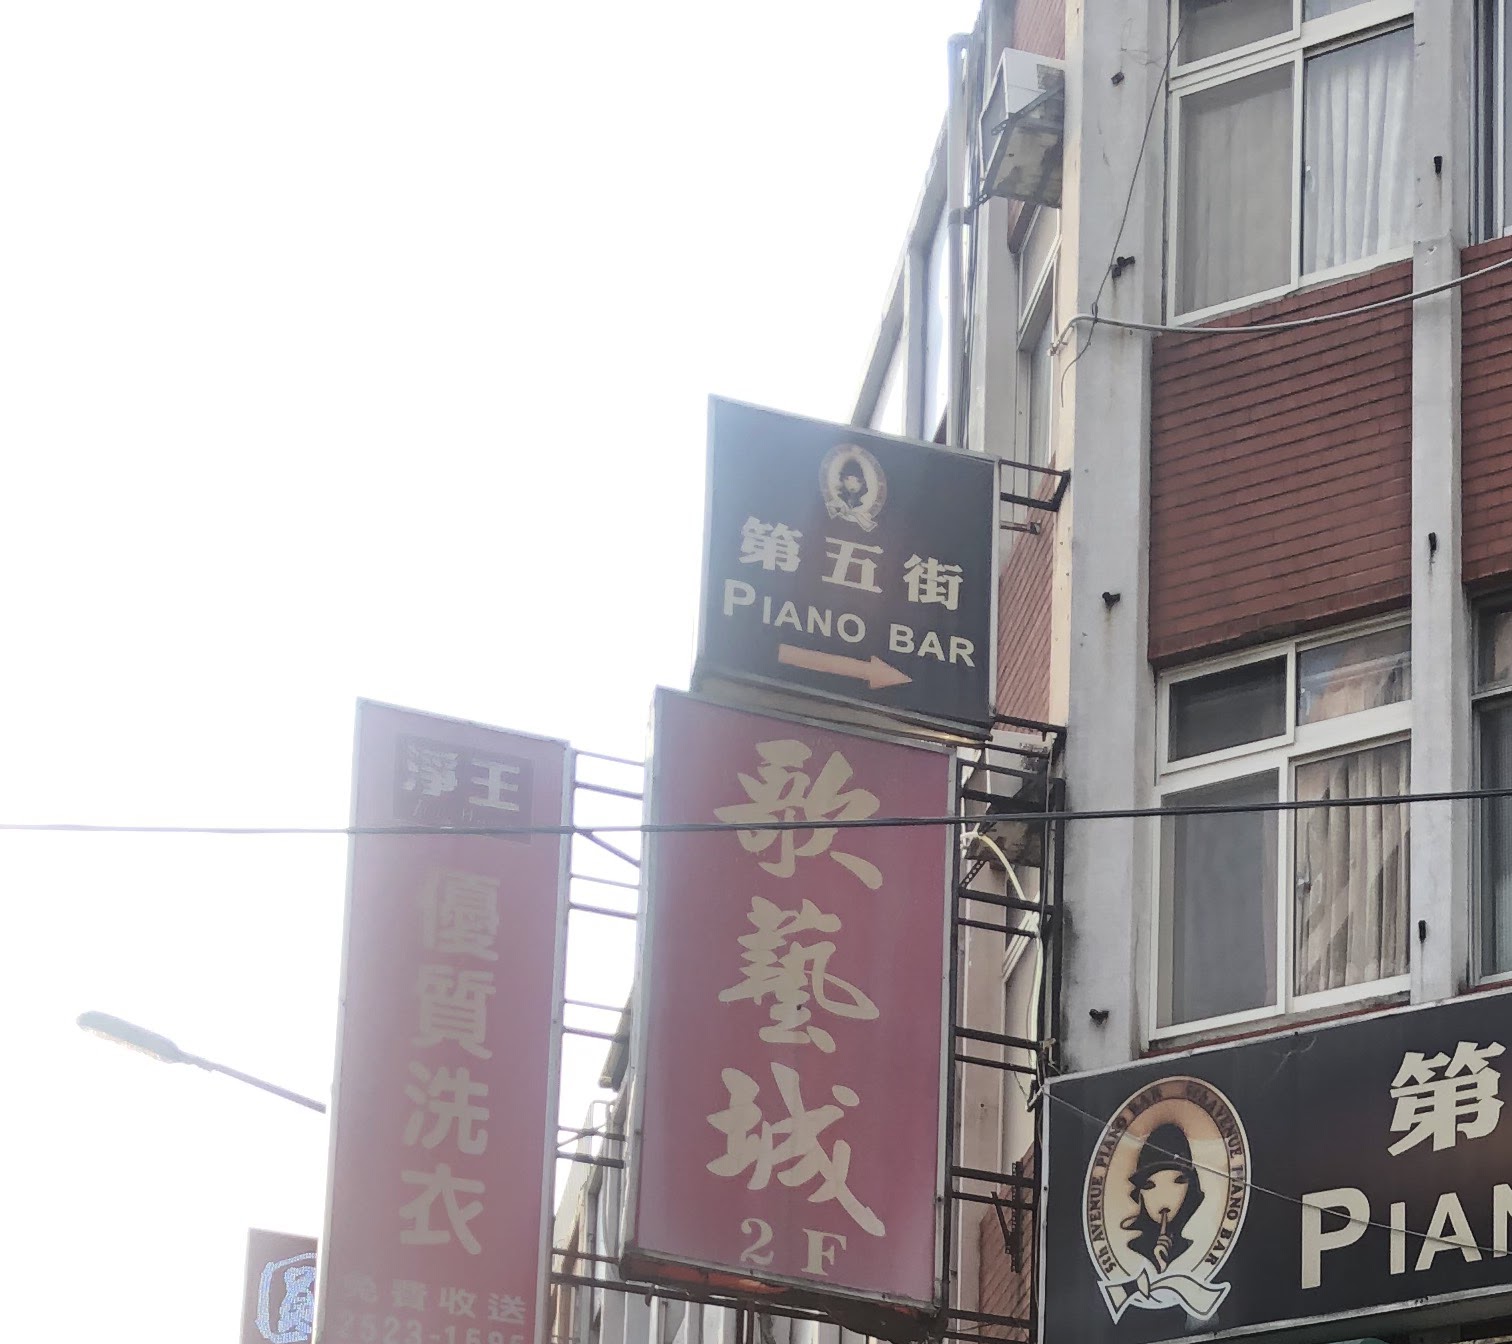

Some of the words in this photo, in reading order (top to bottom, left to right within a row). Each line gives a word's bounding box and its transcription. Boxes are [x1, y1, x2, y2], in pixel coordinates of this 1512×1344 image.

[738, 516, 963, 611] 第五街
[888, 623, 975, 668] BAR
[400, 868, 501, 1256] 優質洗衣
[707, 737, 884, 1237] 歌藝城
